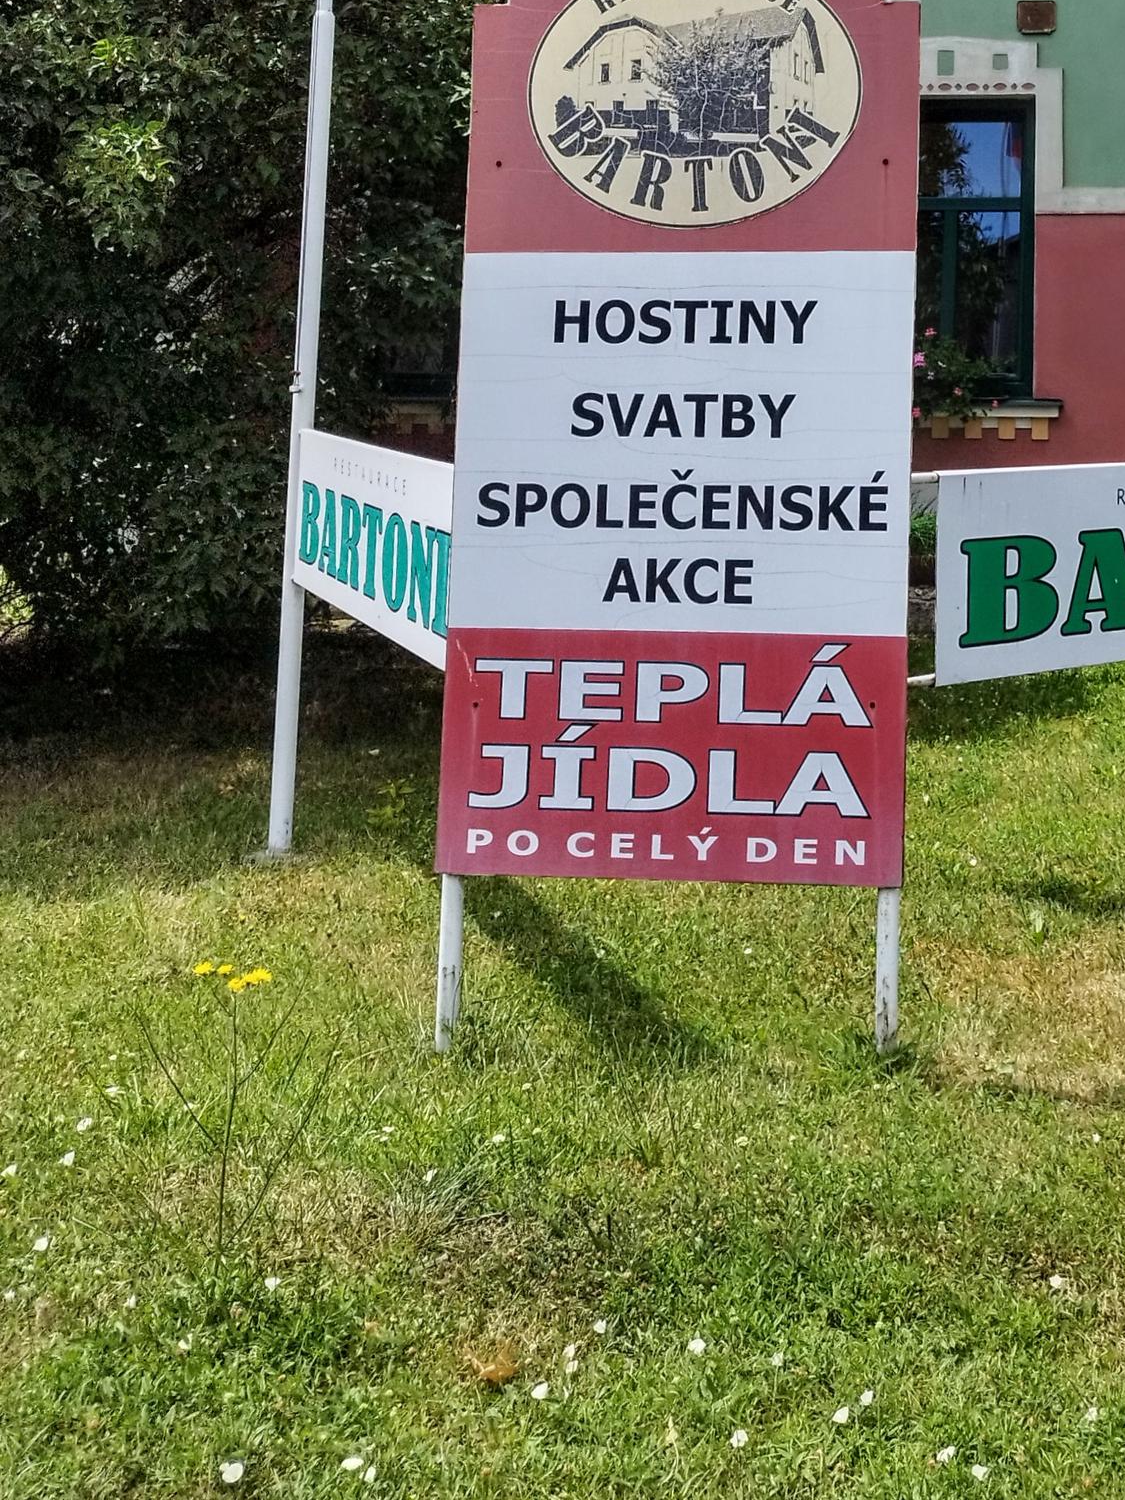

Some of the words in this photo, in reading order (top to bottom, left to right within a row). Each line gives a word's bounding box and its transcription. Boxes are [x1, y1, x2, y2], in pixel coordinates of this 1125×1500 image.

[547, 103, 841, 213] BARTONI
[553, 299, 819, 345] HOSTINY
[570, 393, 797, 439] SVATBY
[475, 468, 889, 532] SPOLEČENSKÉ
[298, 480, 452, 638] BARTONI
[602, 557, 754, 605] AKCE
[474, 643, 873, 728] TEPLÁ
[467, 722, 871, 819] JÍDLA
[466, 828, 539, 855] PO
[566, 826, 719, 861] CELÝ
[746, 837, 867, 866] DEN
